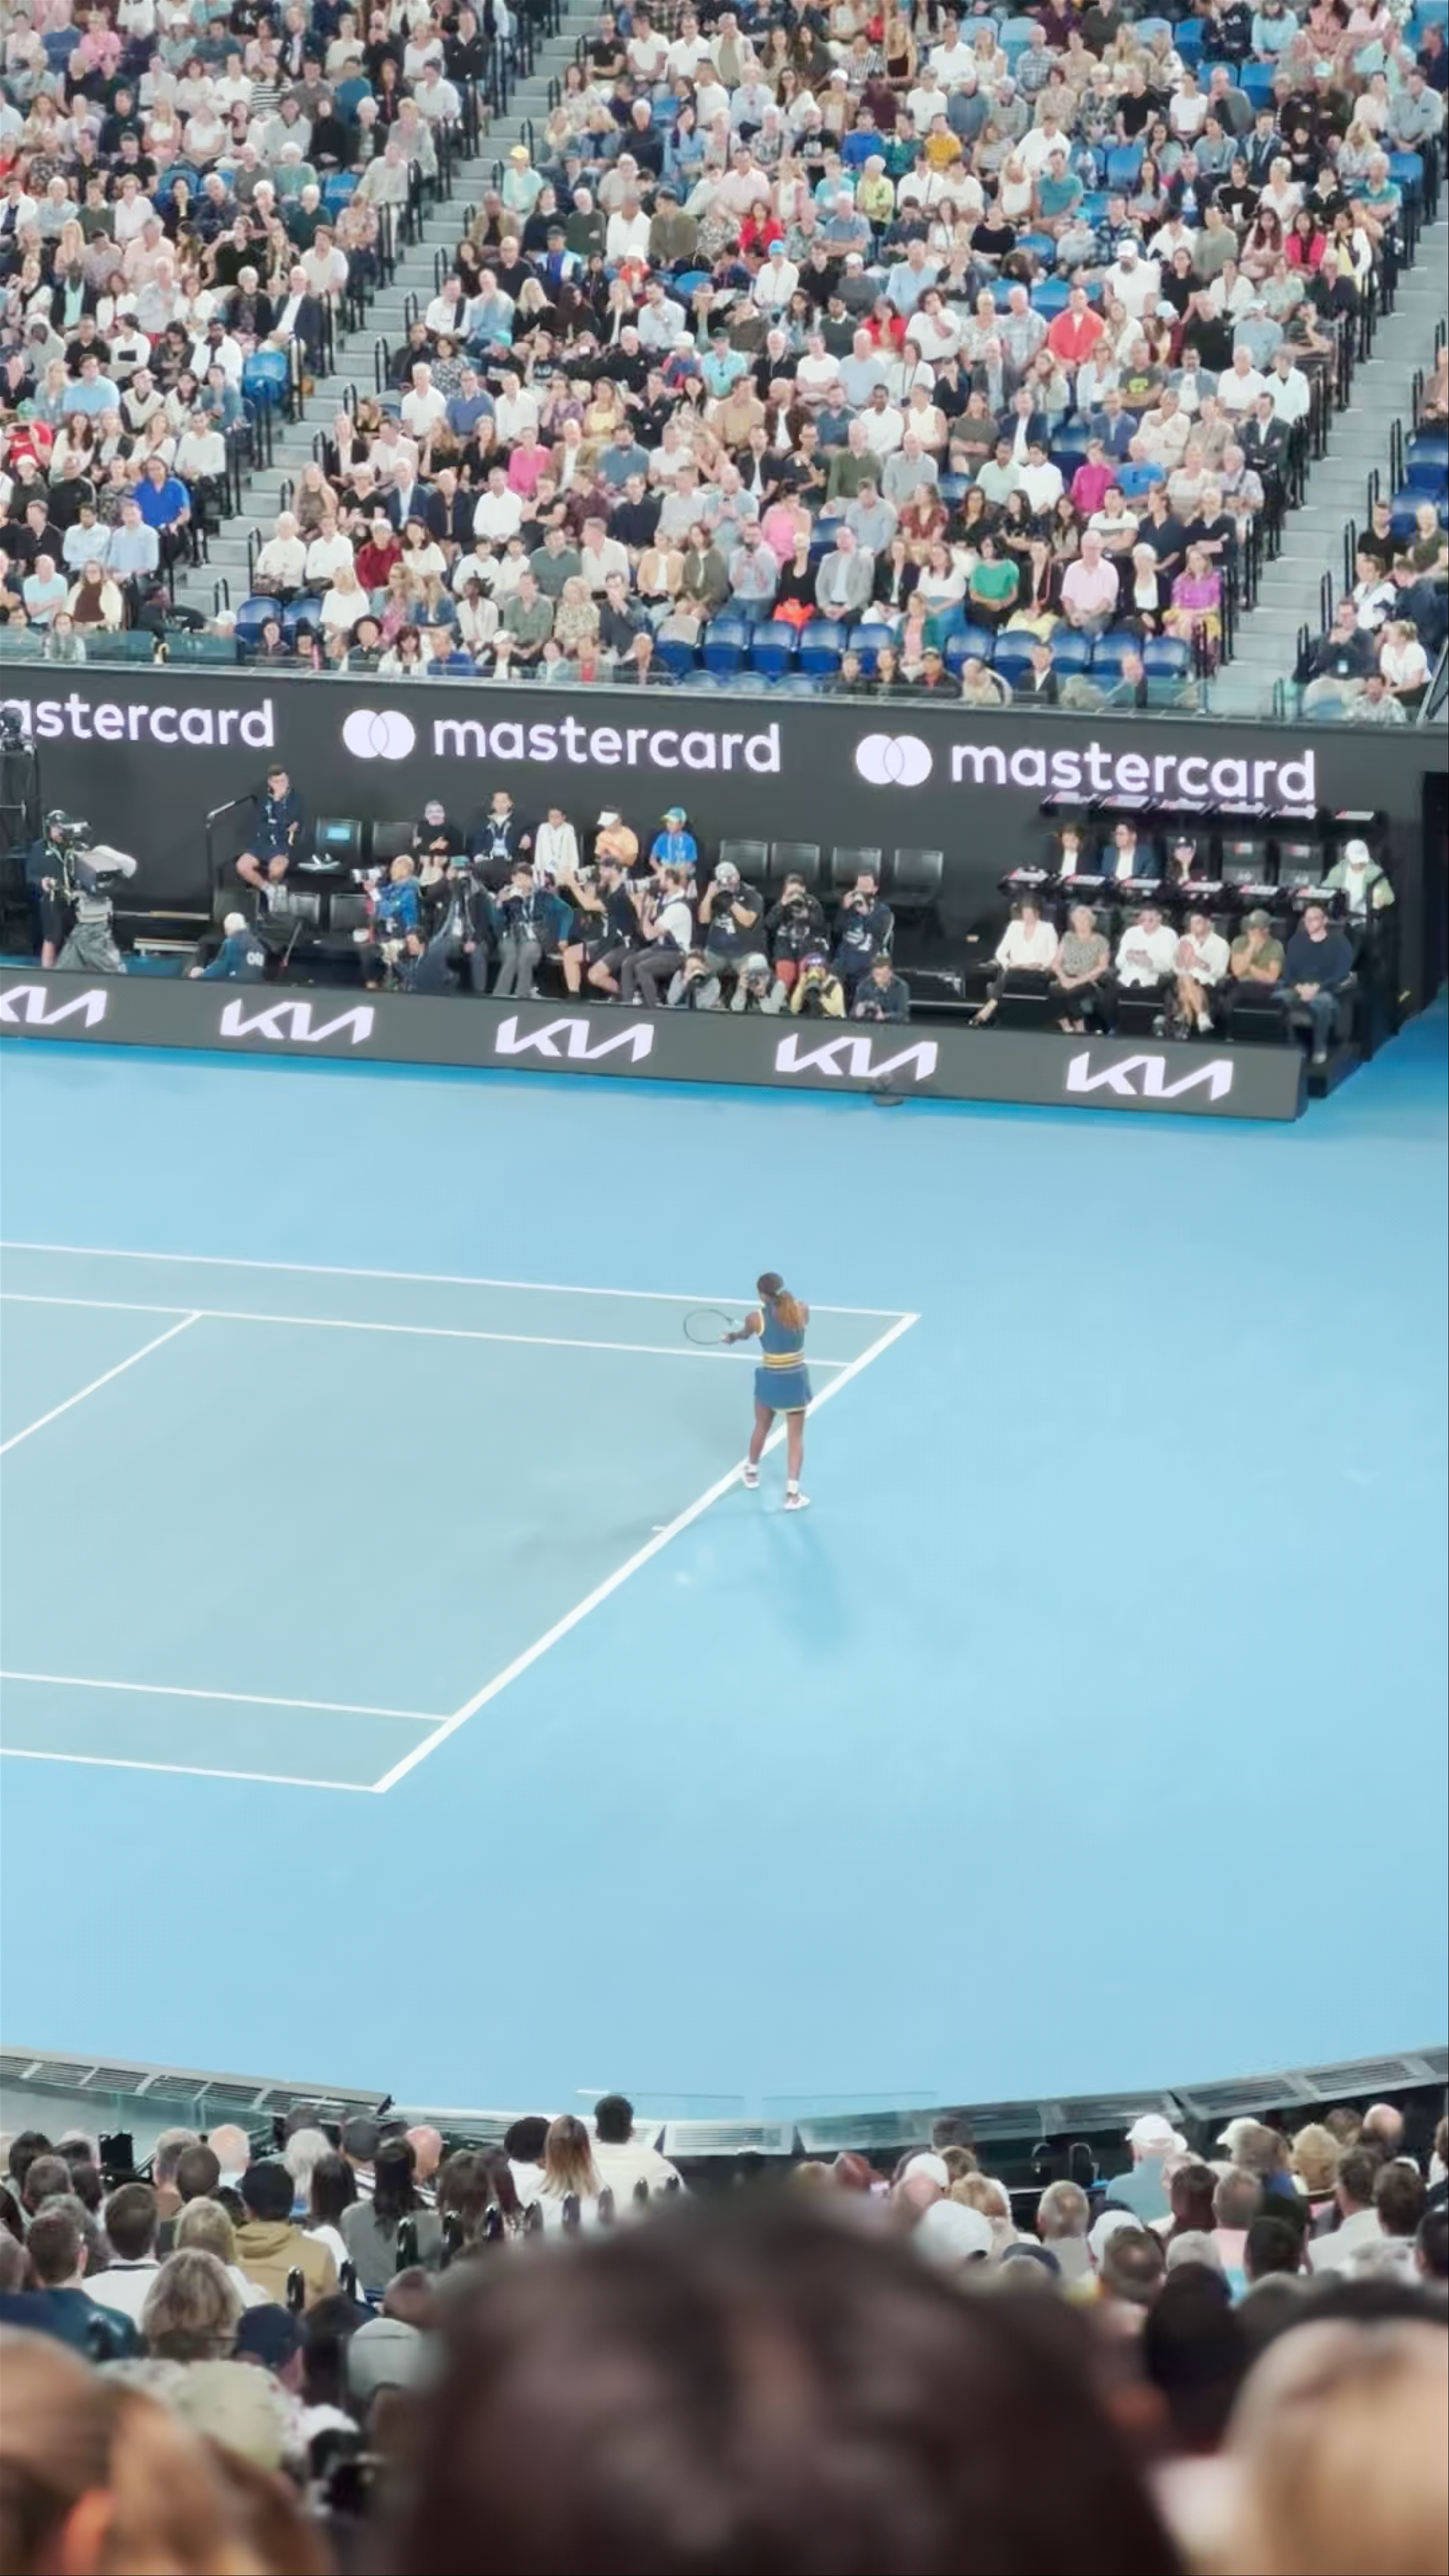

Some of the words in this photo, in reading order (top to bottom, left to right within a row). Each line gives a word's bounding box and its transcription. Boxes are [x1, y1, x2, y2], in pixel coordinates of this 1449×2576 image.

[434, 717, 780, 772] mastercard
[952, 742, 1315, 800] mastercard
[220, 998, 375, 1044] KIA
[495, 1015, 654, 1062] KIA
[775, 1033, 938, 1081] KIA
[1066, 1052, 1234, 1101] KIA
